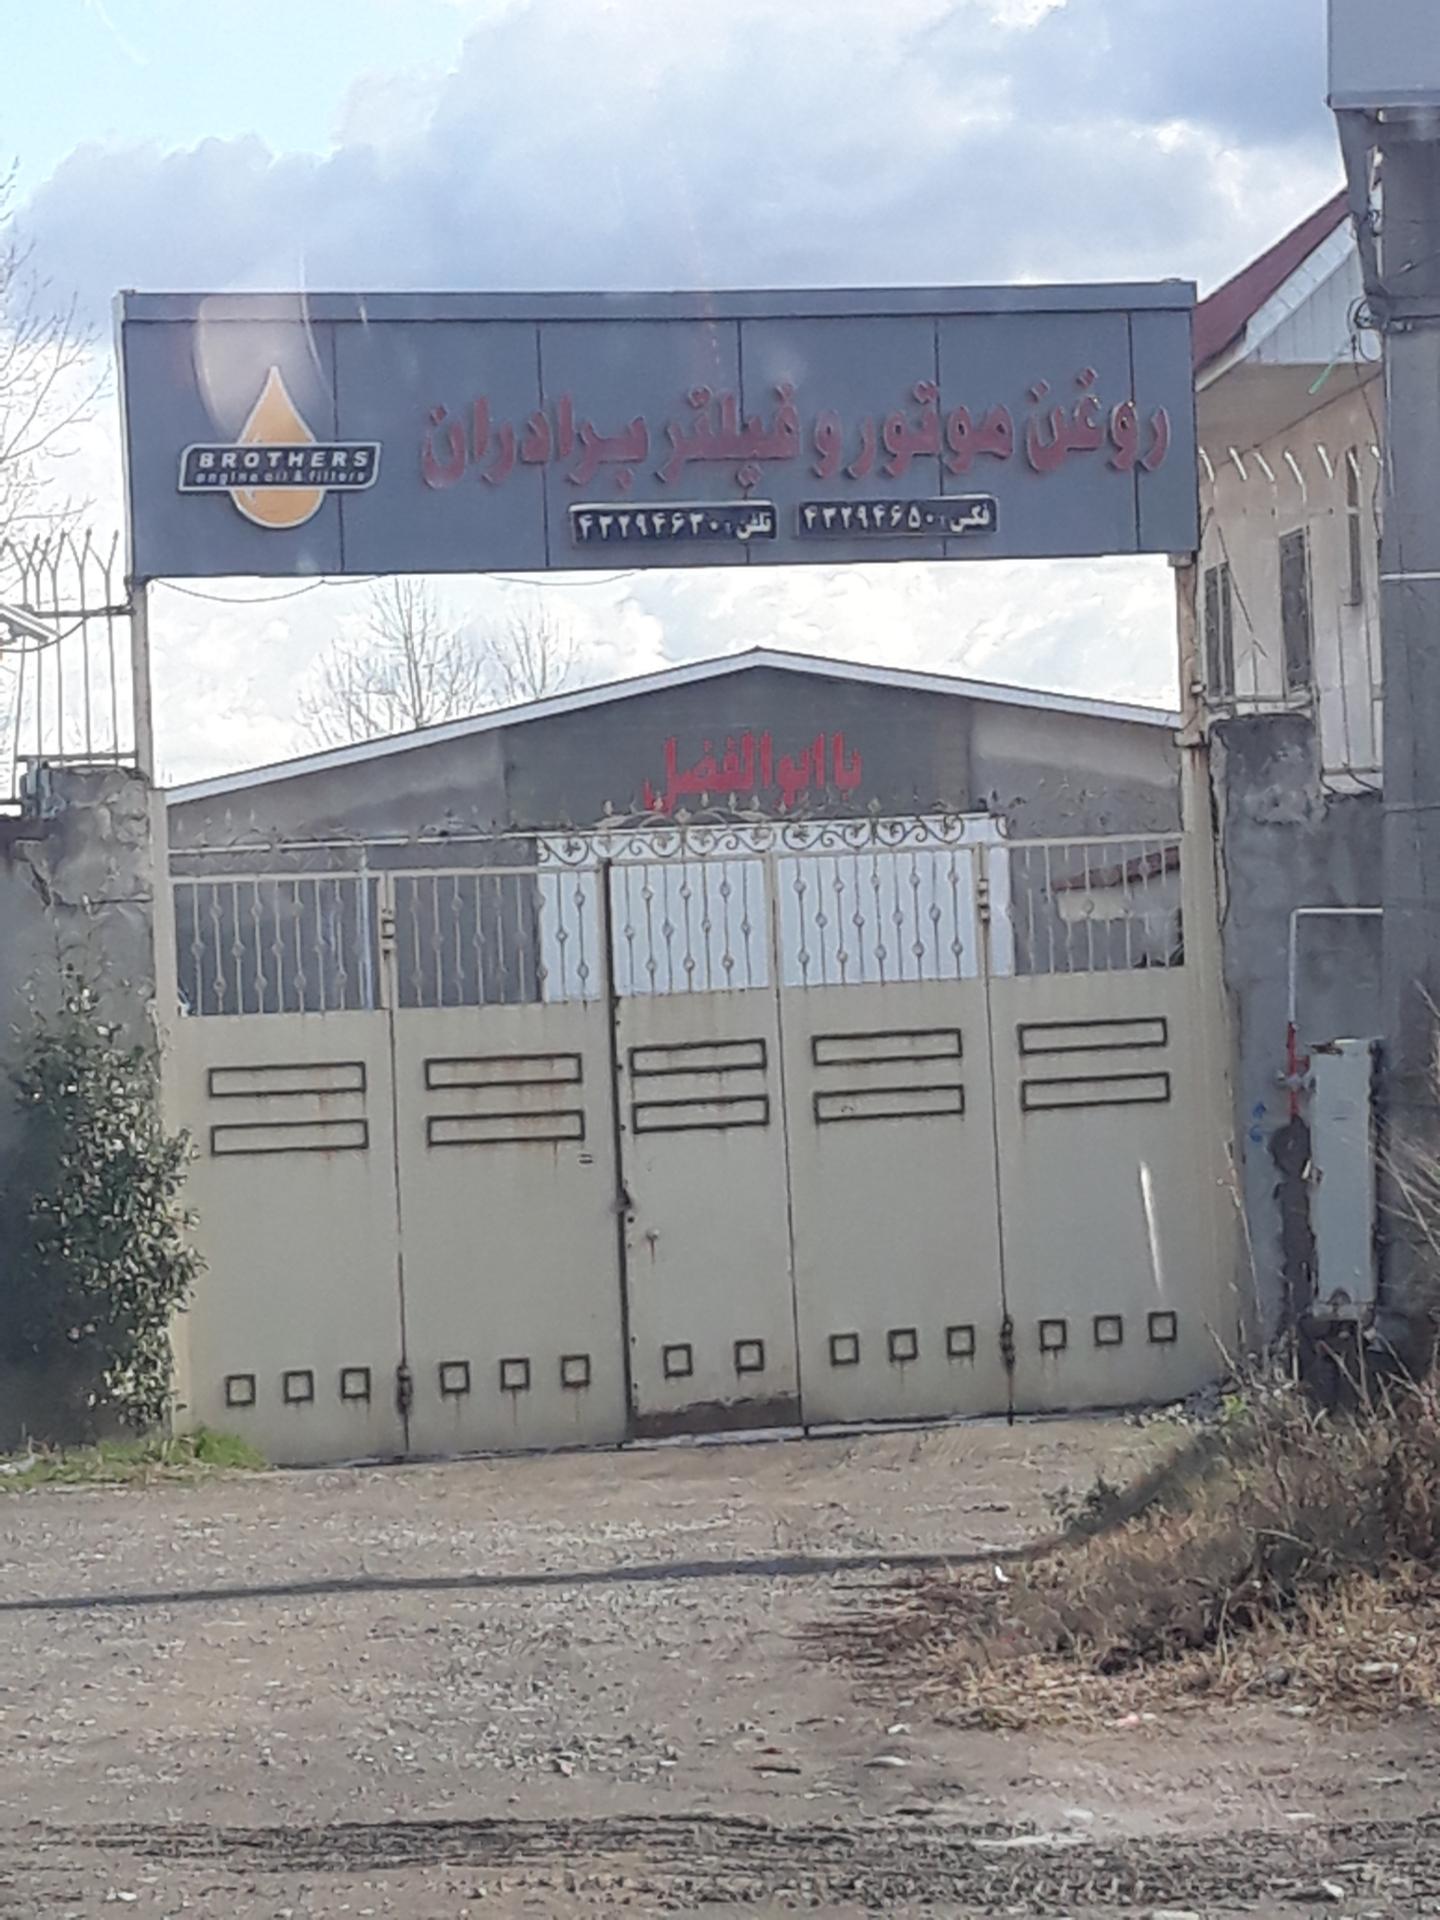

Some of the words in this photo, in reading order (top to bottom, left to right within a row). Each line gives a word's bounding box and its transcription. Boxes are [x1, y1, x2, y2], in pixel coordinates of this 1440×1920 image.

[199, 451, 368, 468] BROTHERS
[422, 391, 649, 490] برادران
[655, 382, 798, 489] فیلتر
[812, 409, 842, 479] و
[846, 380, 1014, 480] موتور
[1024, 367, 1171, 472] روغن
[195, 472, 259, 485] engine
